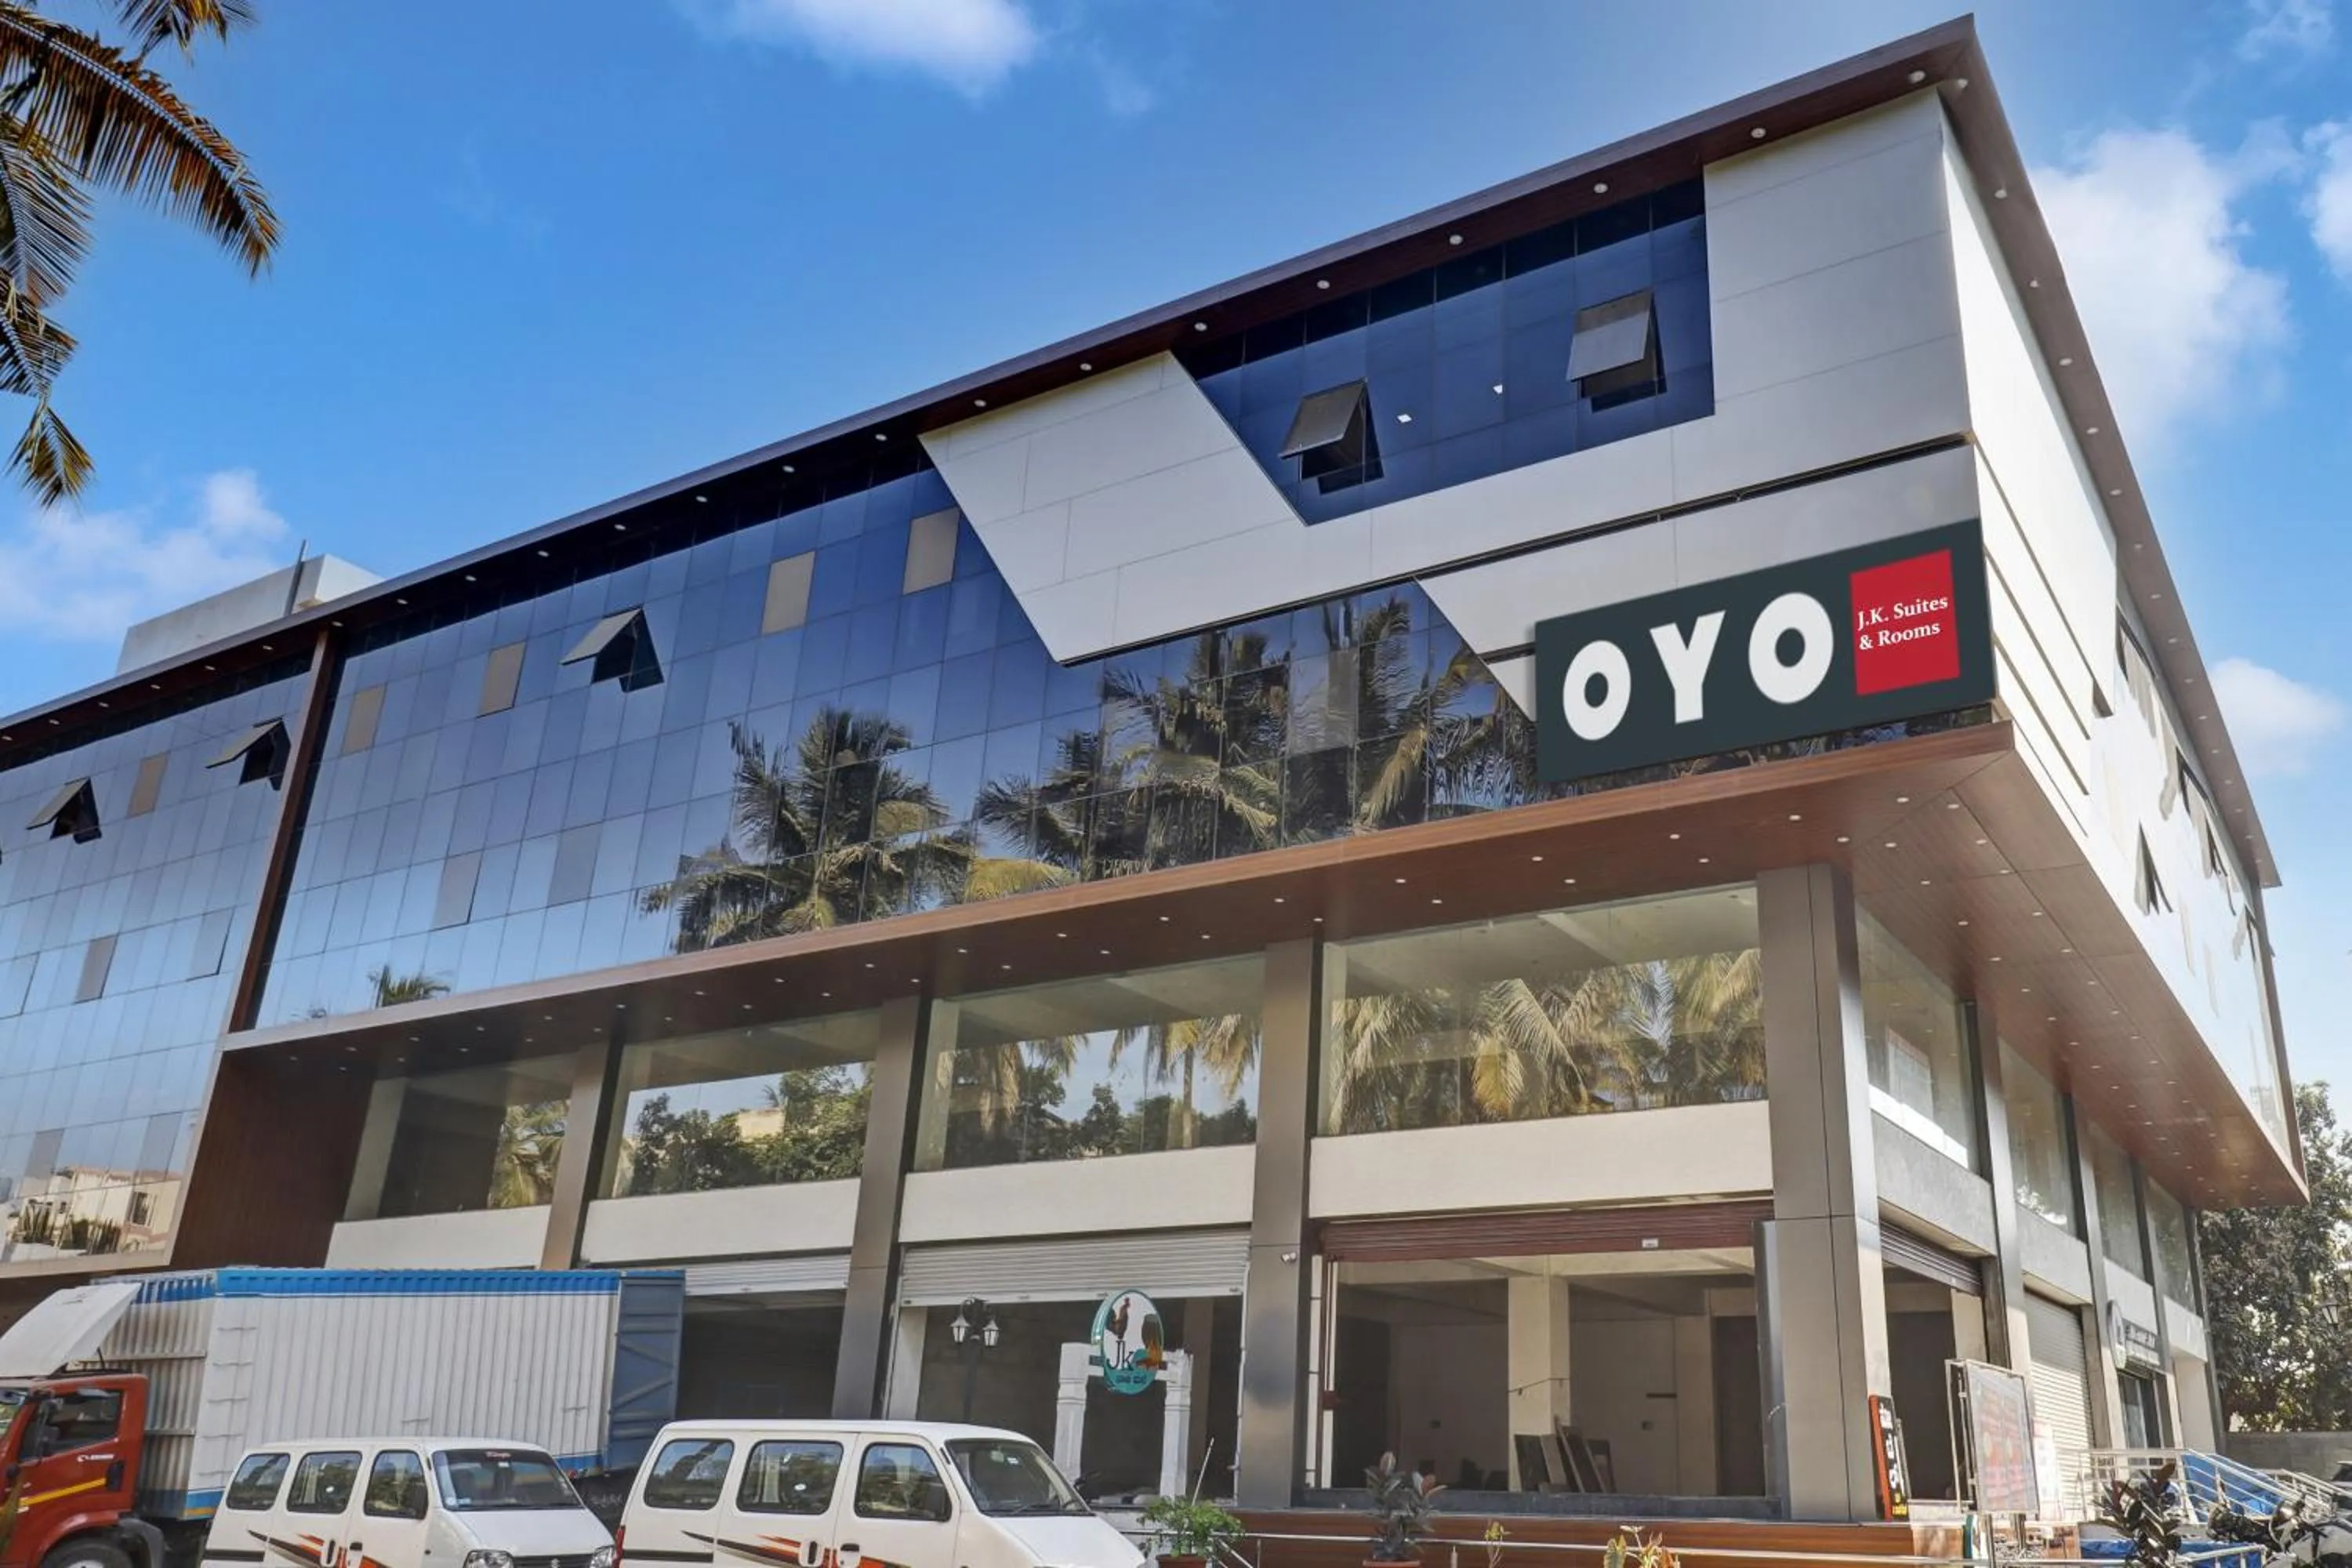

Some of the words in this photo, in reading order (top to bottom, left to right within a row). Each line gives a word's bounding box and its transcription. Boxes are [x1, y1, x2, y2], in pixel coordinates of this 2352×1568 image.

[1857, 607, 1889, 630] J.K.
[1893, 597, 1948, 619] Suites
[1859, 634, 1874, 650] &
[1878, 622, 1940, 646] Rooms
[1563, 592, 1834, 741] OYO
